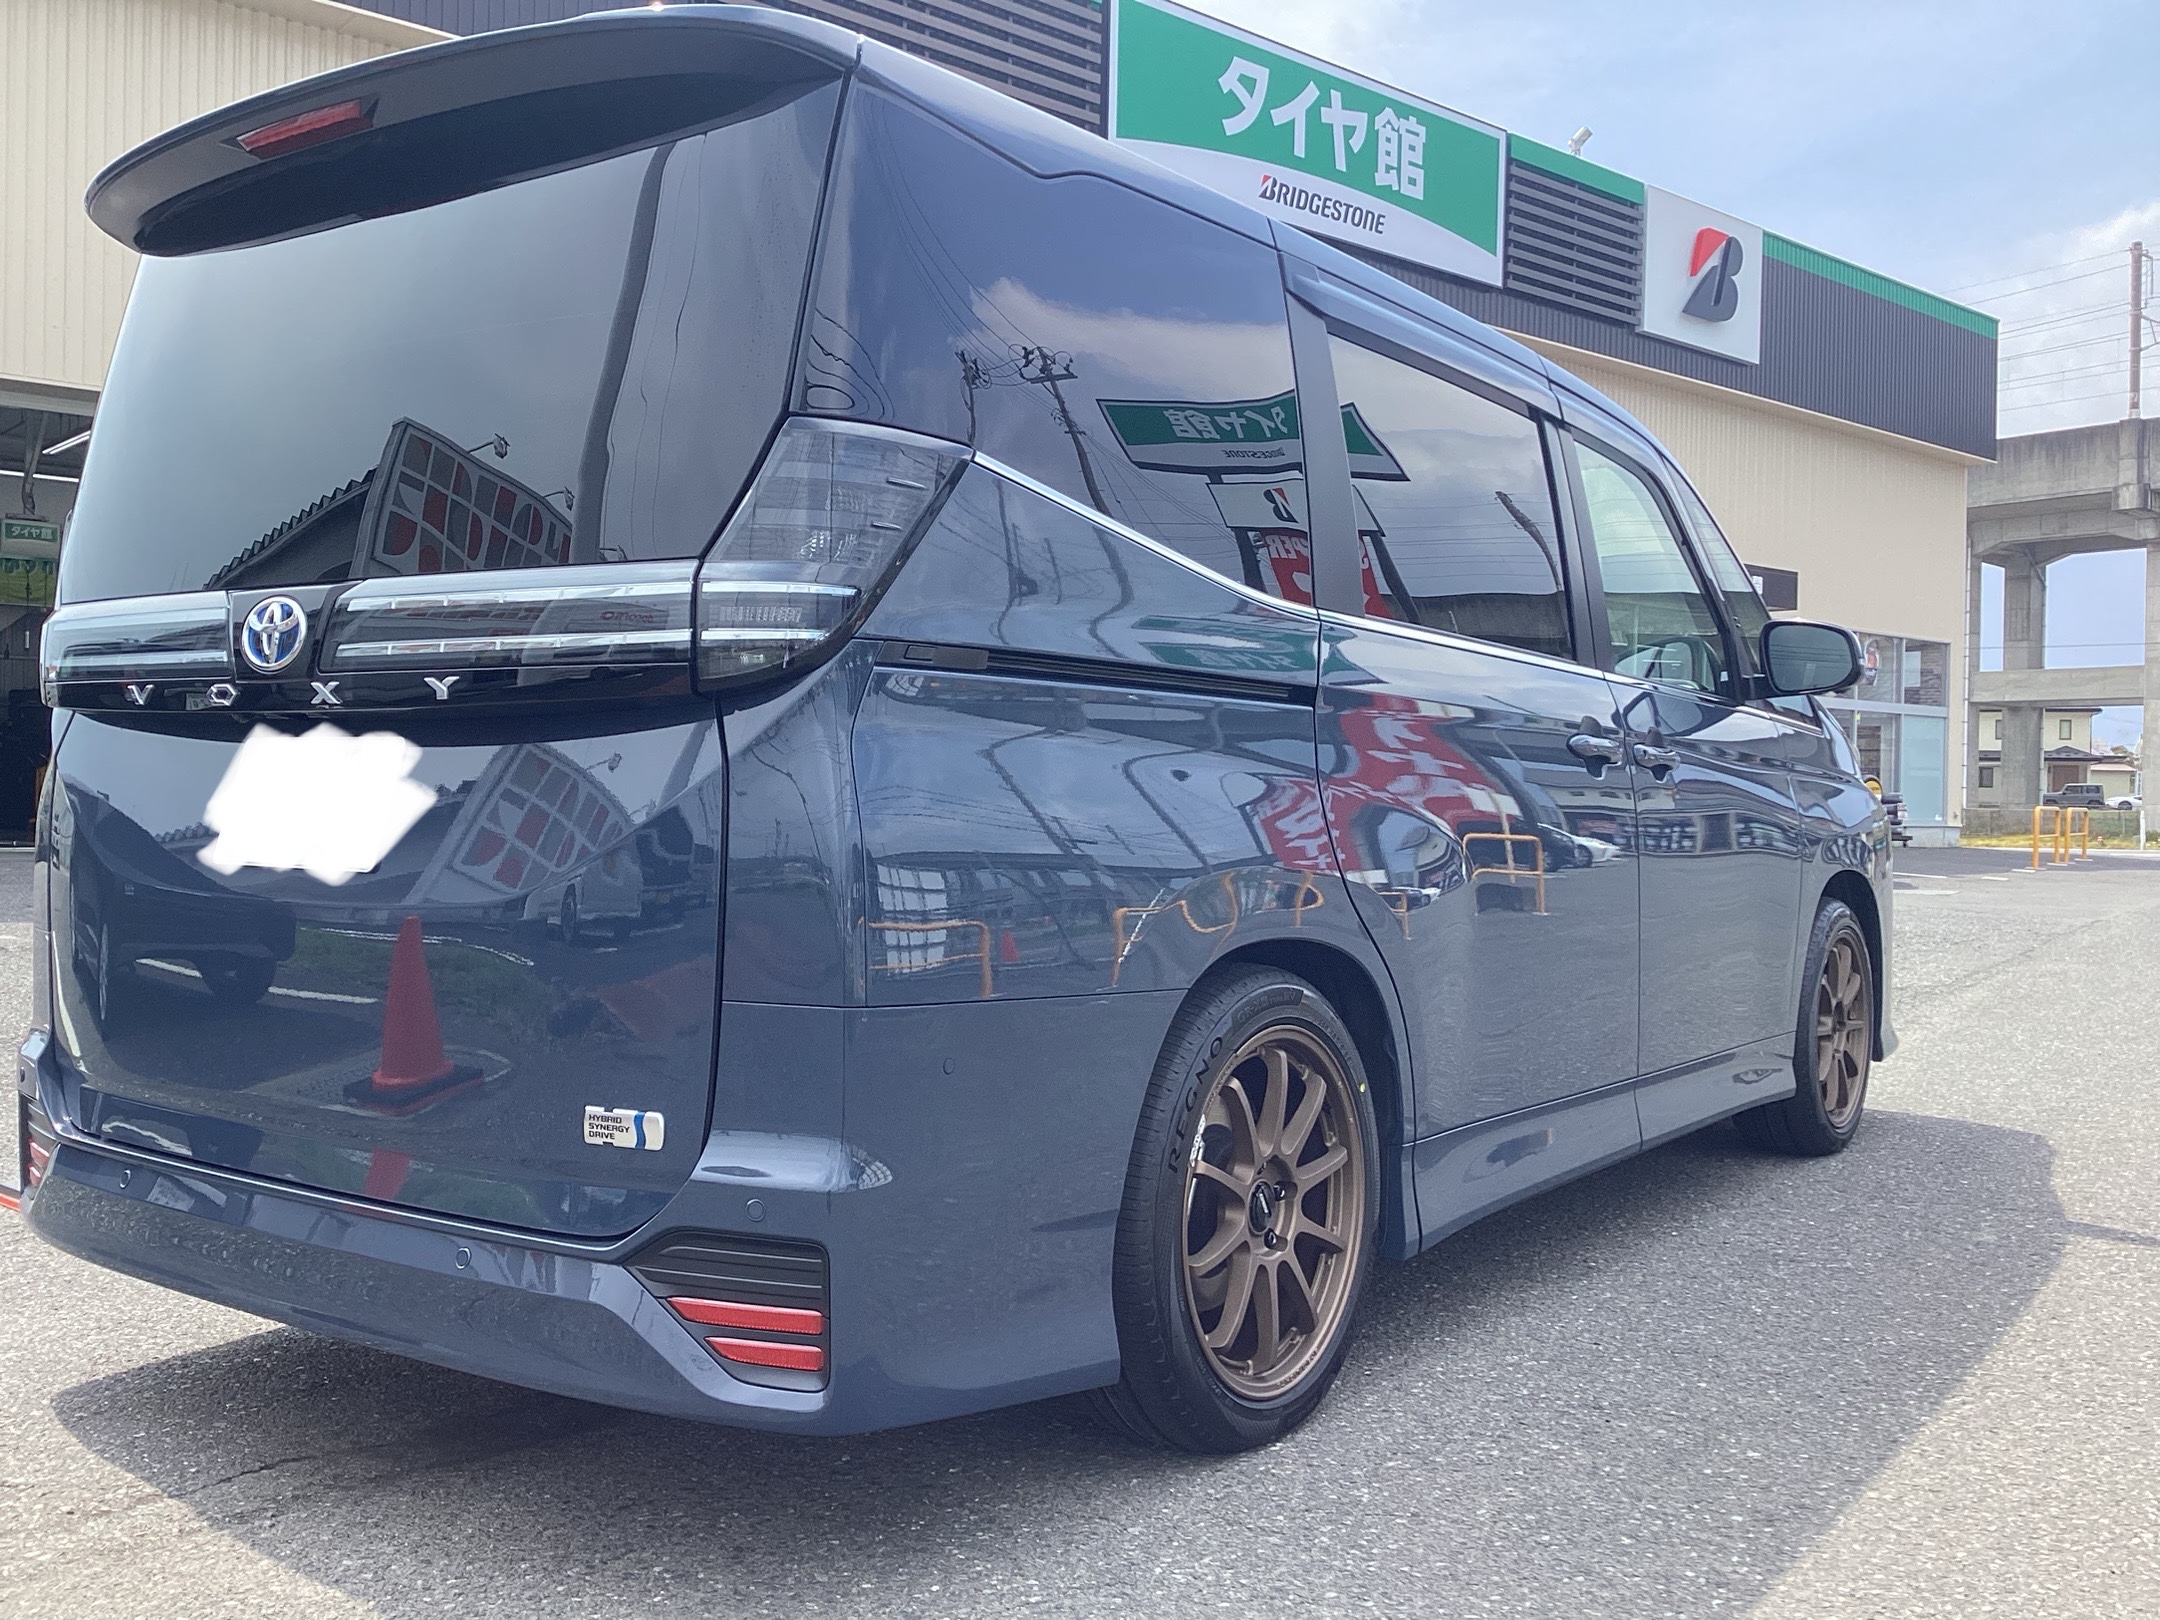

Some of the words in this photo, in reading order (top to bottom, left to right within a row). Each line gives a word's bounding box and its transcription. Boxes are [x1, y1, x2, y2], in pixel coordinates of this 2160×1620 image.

[1218, 56, 1426, 200] タイヤ館
[1258, 174, 1386, 234] BRIDGESTONE
[127, 676, 460, 706] VOXY
[588, 1114, 622, 1124] HYBRID
[1168, 1036, 1223, 1174] REGNO
[588, 1122, 630, 1133] SYNERGY
[588, 1130, 615, 1140] DRIVE
